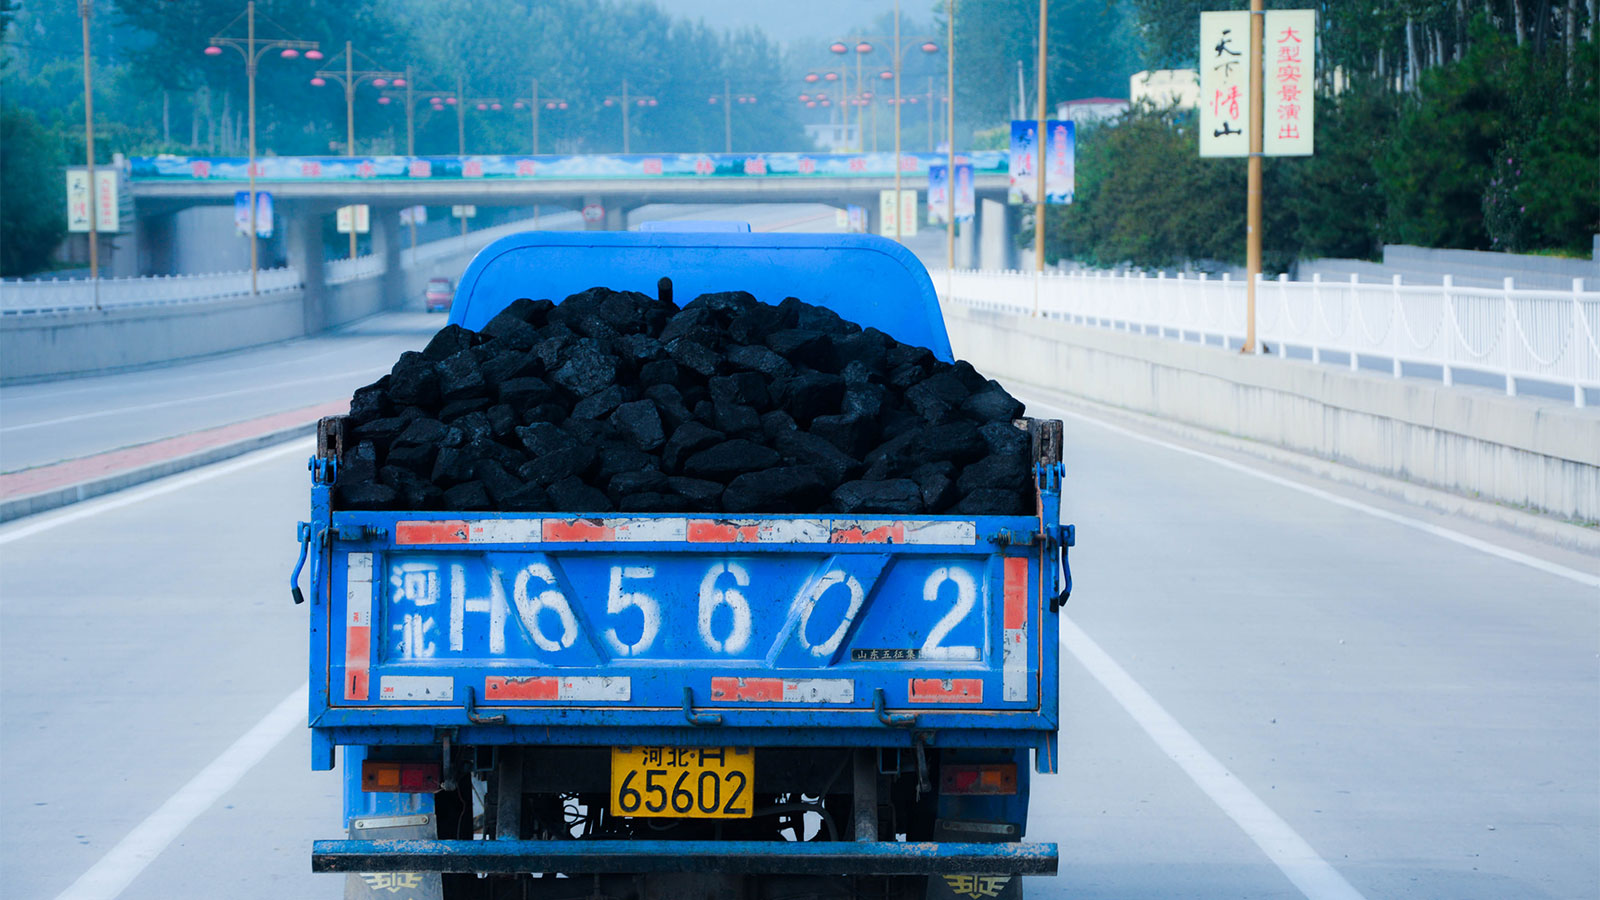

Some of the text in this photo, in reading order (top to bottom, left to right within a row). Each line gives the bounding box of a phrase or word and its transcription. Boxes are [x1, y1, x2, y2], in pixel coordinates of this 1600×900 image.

[1209, 29, 1243, 138] 天下情山
[1276, 26, 1303, 140] 大型实景演出
[390, 562, 441, 660] 河北
[618, 769, 747, 814] 65602
